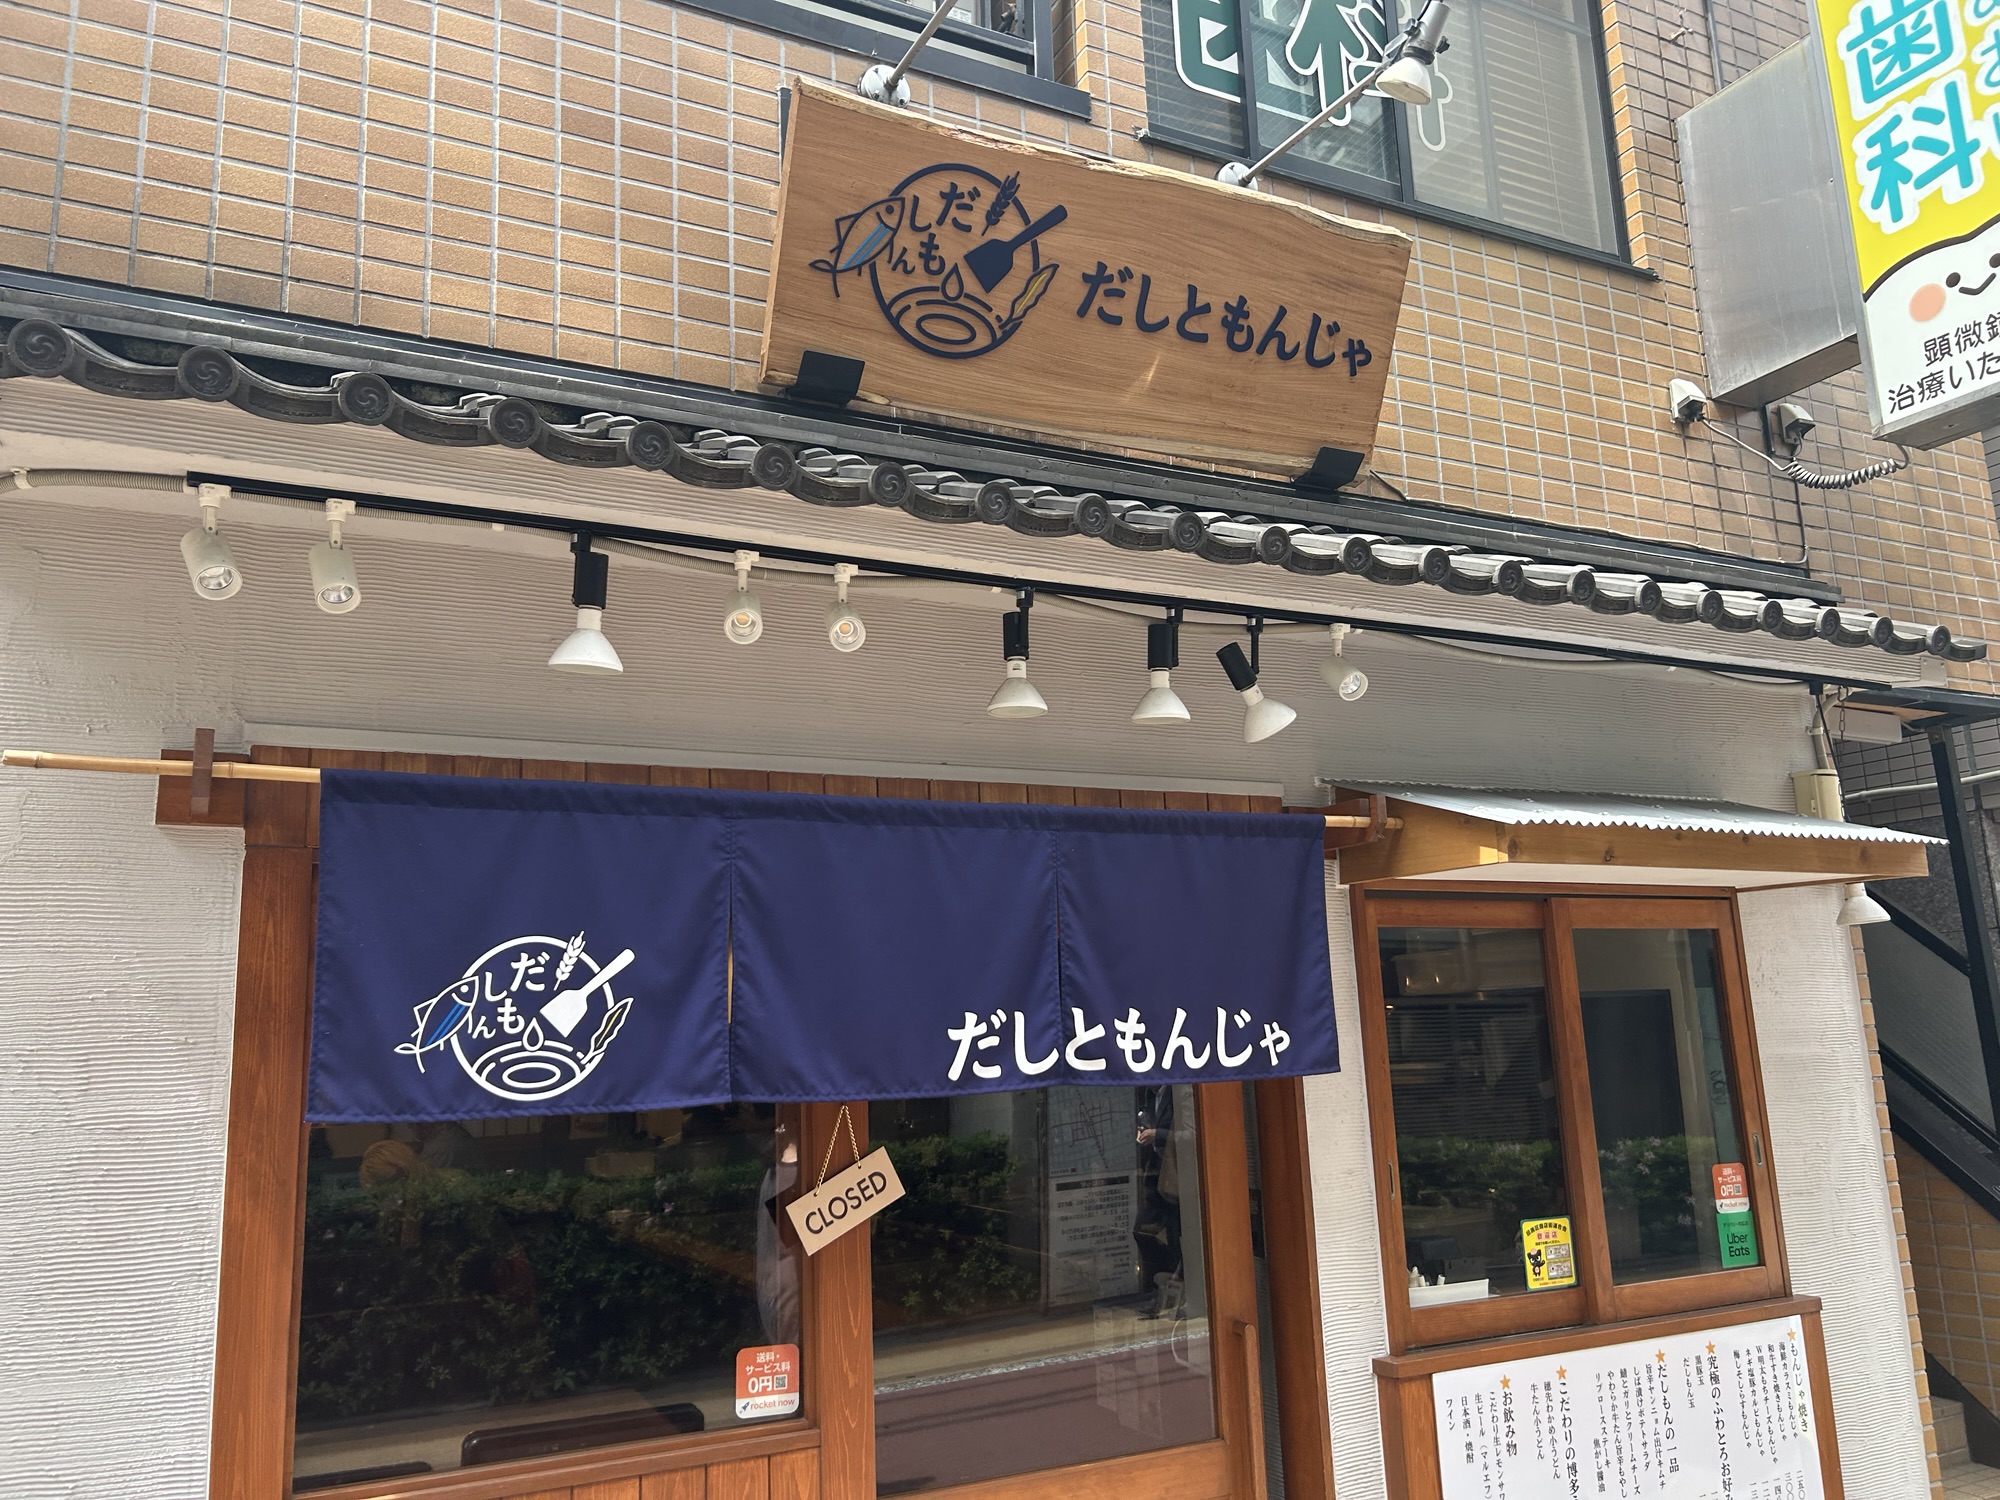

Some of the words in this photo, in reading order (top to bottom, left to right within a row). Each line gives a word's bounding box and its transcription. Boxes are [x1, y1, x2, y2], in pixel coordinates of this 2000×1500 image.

[1846, 0, 1981, 223] 歯科
[1075, 260, 1373, 377] だしともんじゃ
[947, 1006, 1291, 1081] だしともんじゃ
[805, 1171, 887, 1234] CLOSED
[1726, 1233, 1748, 1245] Uber
[1728, 1245, 1751, 1258] Eats
[745, 1361, 791, 1376] サービス料
[748, 1375, 773, 1394] 0円
[1683, 1357, 1695, 1408] だしもん玉
[1791, 1343, 1808, 1432] もんじゃ焼き
[750, 1401, 777, 1411] rocket
[777, 1399, 796, 1407] now
[1446, 1399, 1455, 1430] ワイン
[1502, 1391, 1517, 1457] お飲み物
[1657, 1362, 1679, 1473] だしもんの一品
[1559, 1382, 1579, 1500] こだわりの博多
